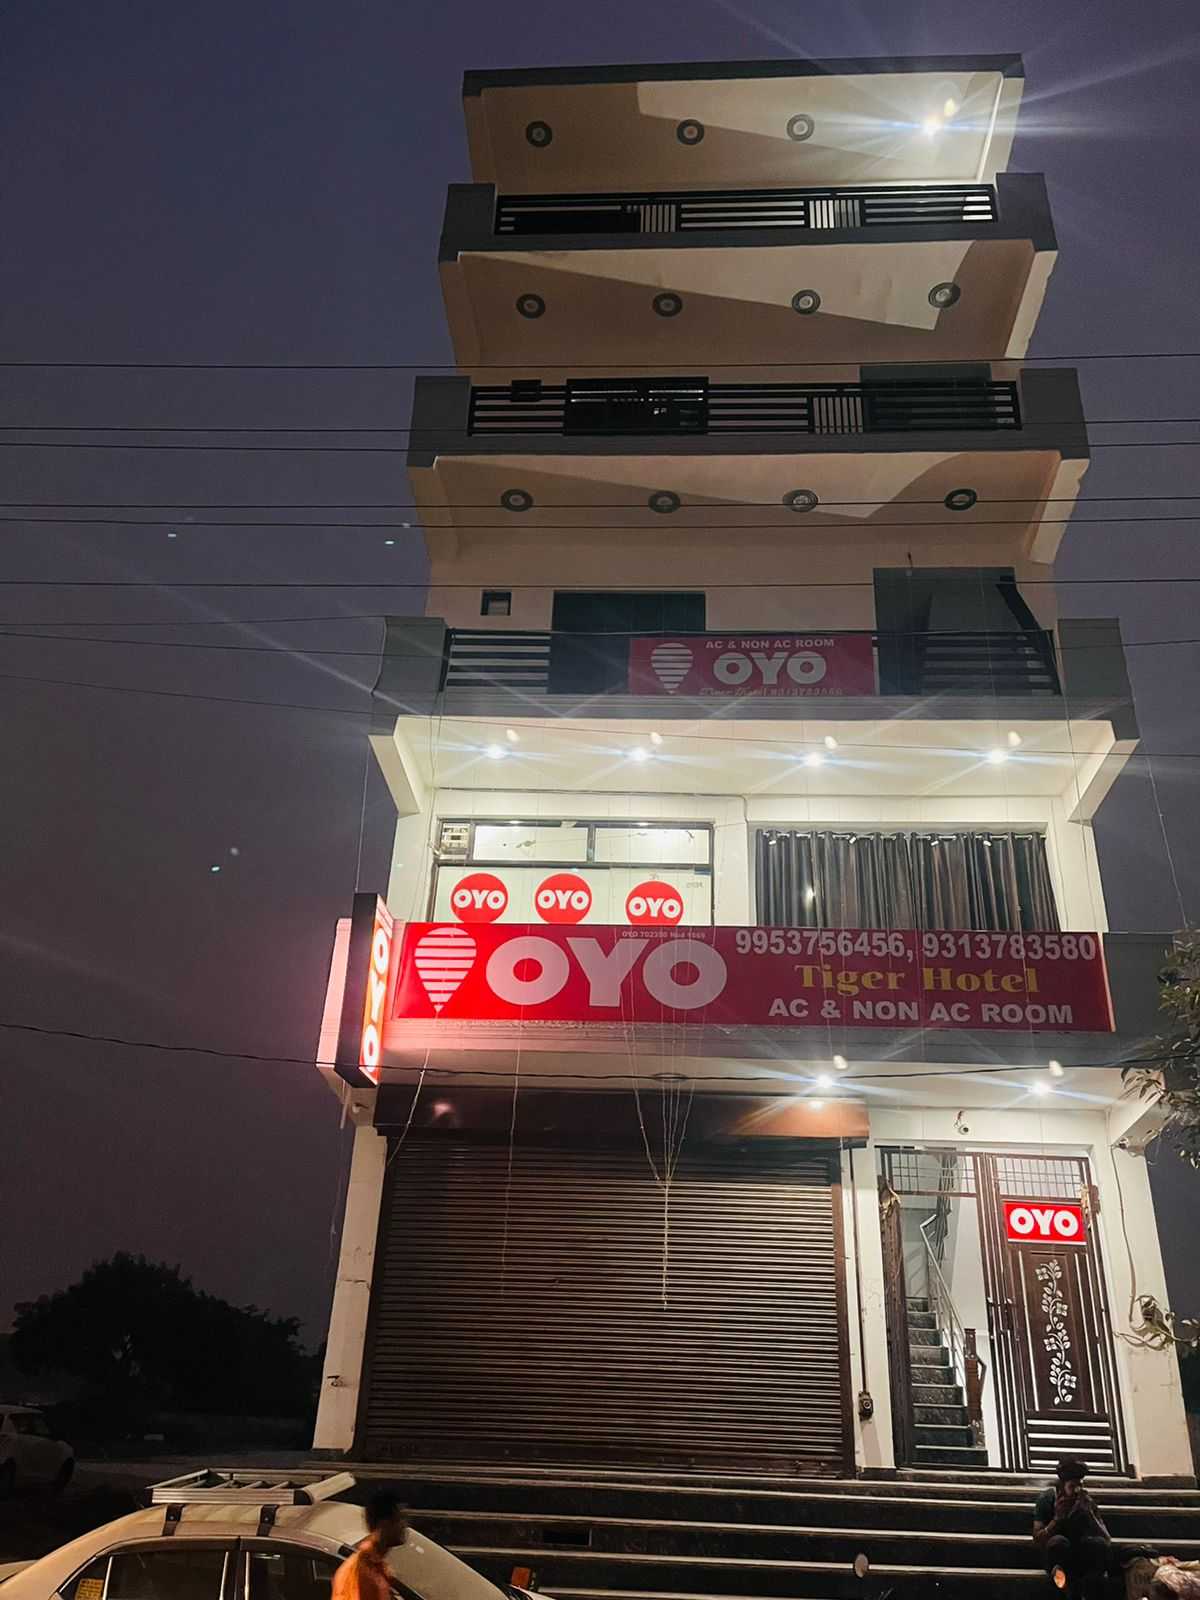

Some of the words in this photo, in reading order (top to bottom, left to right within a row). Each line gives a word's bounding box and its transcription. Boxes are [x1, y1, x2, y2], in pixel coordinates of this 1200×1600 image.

[705, 640, 722, 649] AC
[728, 640, 736, 649] &
[741, 640, 769, 649] NON
[774, 639, 792, 648] AC
[795, 638, 834, 648] ROOM
[713, 651, 827, 685] OYO
[453, 888, 505, 910] OYO
[537, 888, 590, 911] OYO
[628, 896, 681, 918] OYO
[735, 929, 914, 962] 9953756456,
[922, 934, 1096, 961] 9313783580
[485, 935, 728, 1010] OYO
[794, 964, 906, 997] Tiger
[921, 966, 1041, 994] Hotel
[361, 927, 389, 1073] OYO
[768, 998, 809, 1018] AC
[821, 999, 841, 1019] &
[853, 1001, 919, 1022] NON
[930, 1002, 970, 1023] AC
[982, 1003, 1073, 1024] ROOM
[1009, 1207, 1079, 1237] OYO
